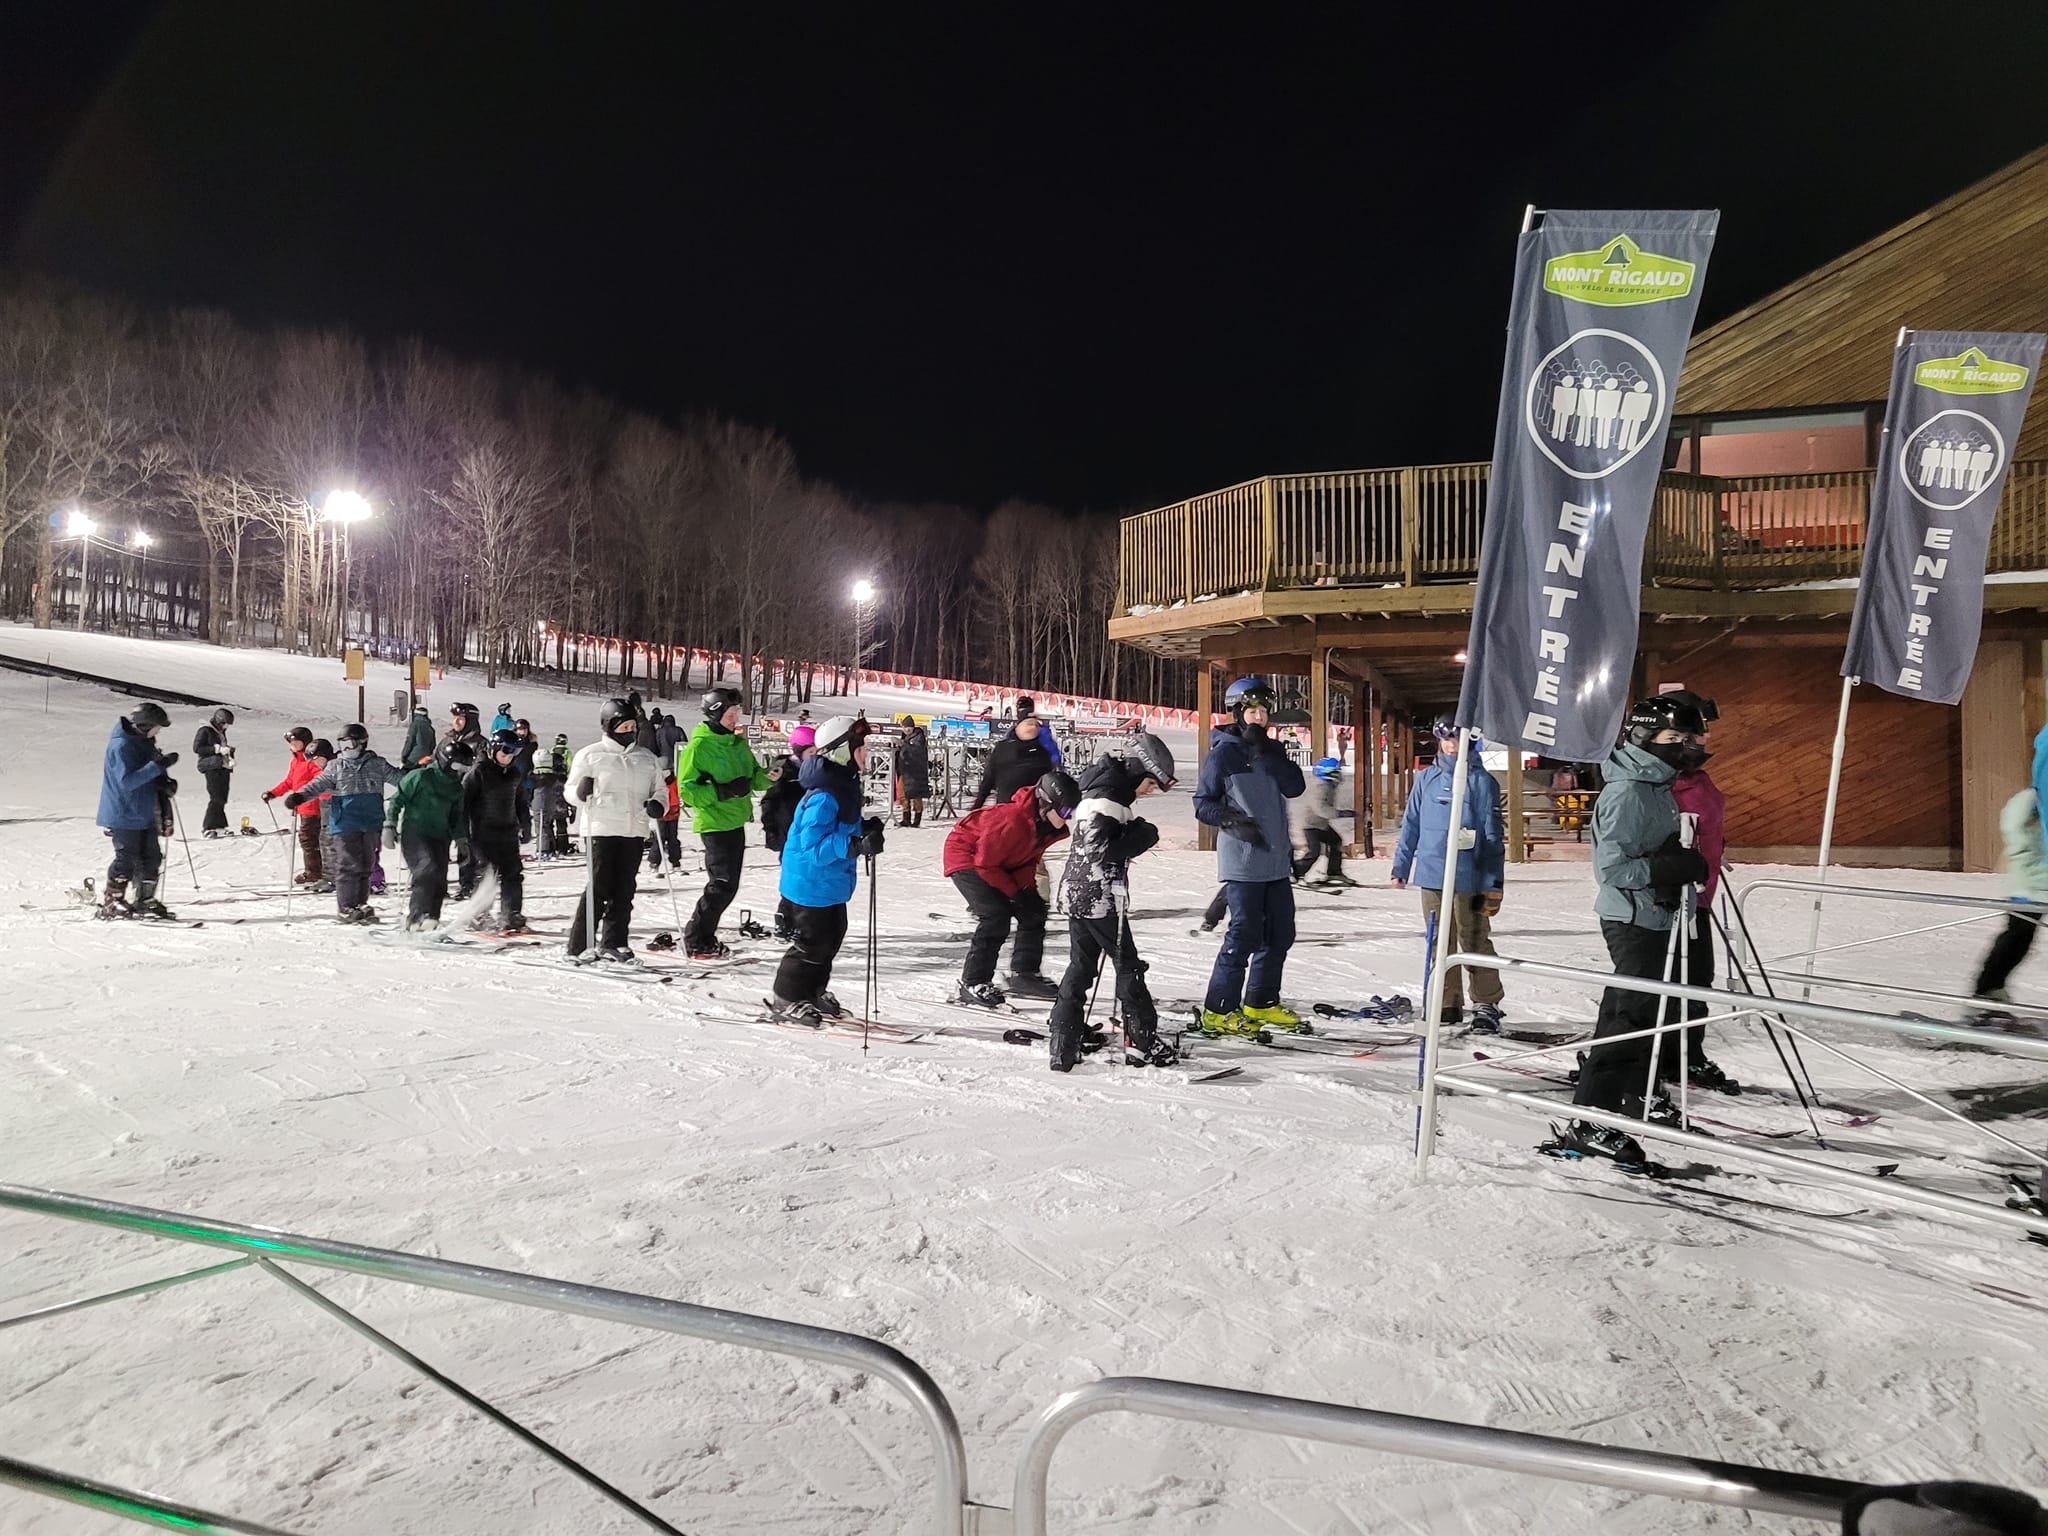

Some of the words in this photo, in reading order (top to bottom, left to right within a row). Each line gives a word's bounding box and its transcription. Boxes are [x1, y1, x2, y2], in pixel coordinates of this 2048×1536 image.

[1552, 267, 1603, 282] MONT
[1607, 269, 1686, 286] RIGAUD
[1921, 368, 1959, 379] MONT
[1962, 370, 2021, 383] RIGAUD
[1896, 527, 1953, 691] ENTRÉE
[1521, 501, 1593, 746] ENTRÉE
[1631, 715, 1657, 723] SMITH
